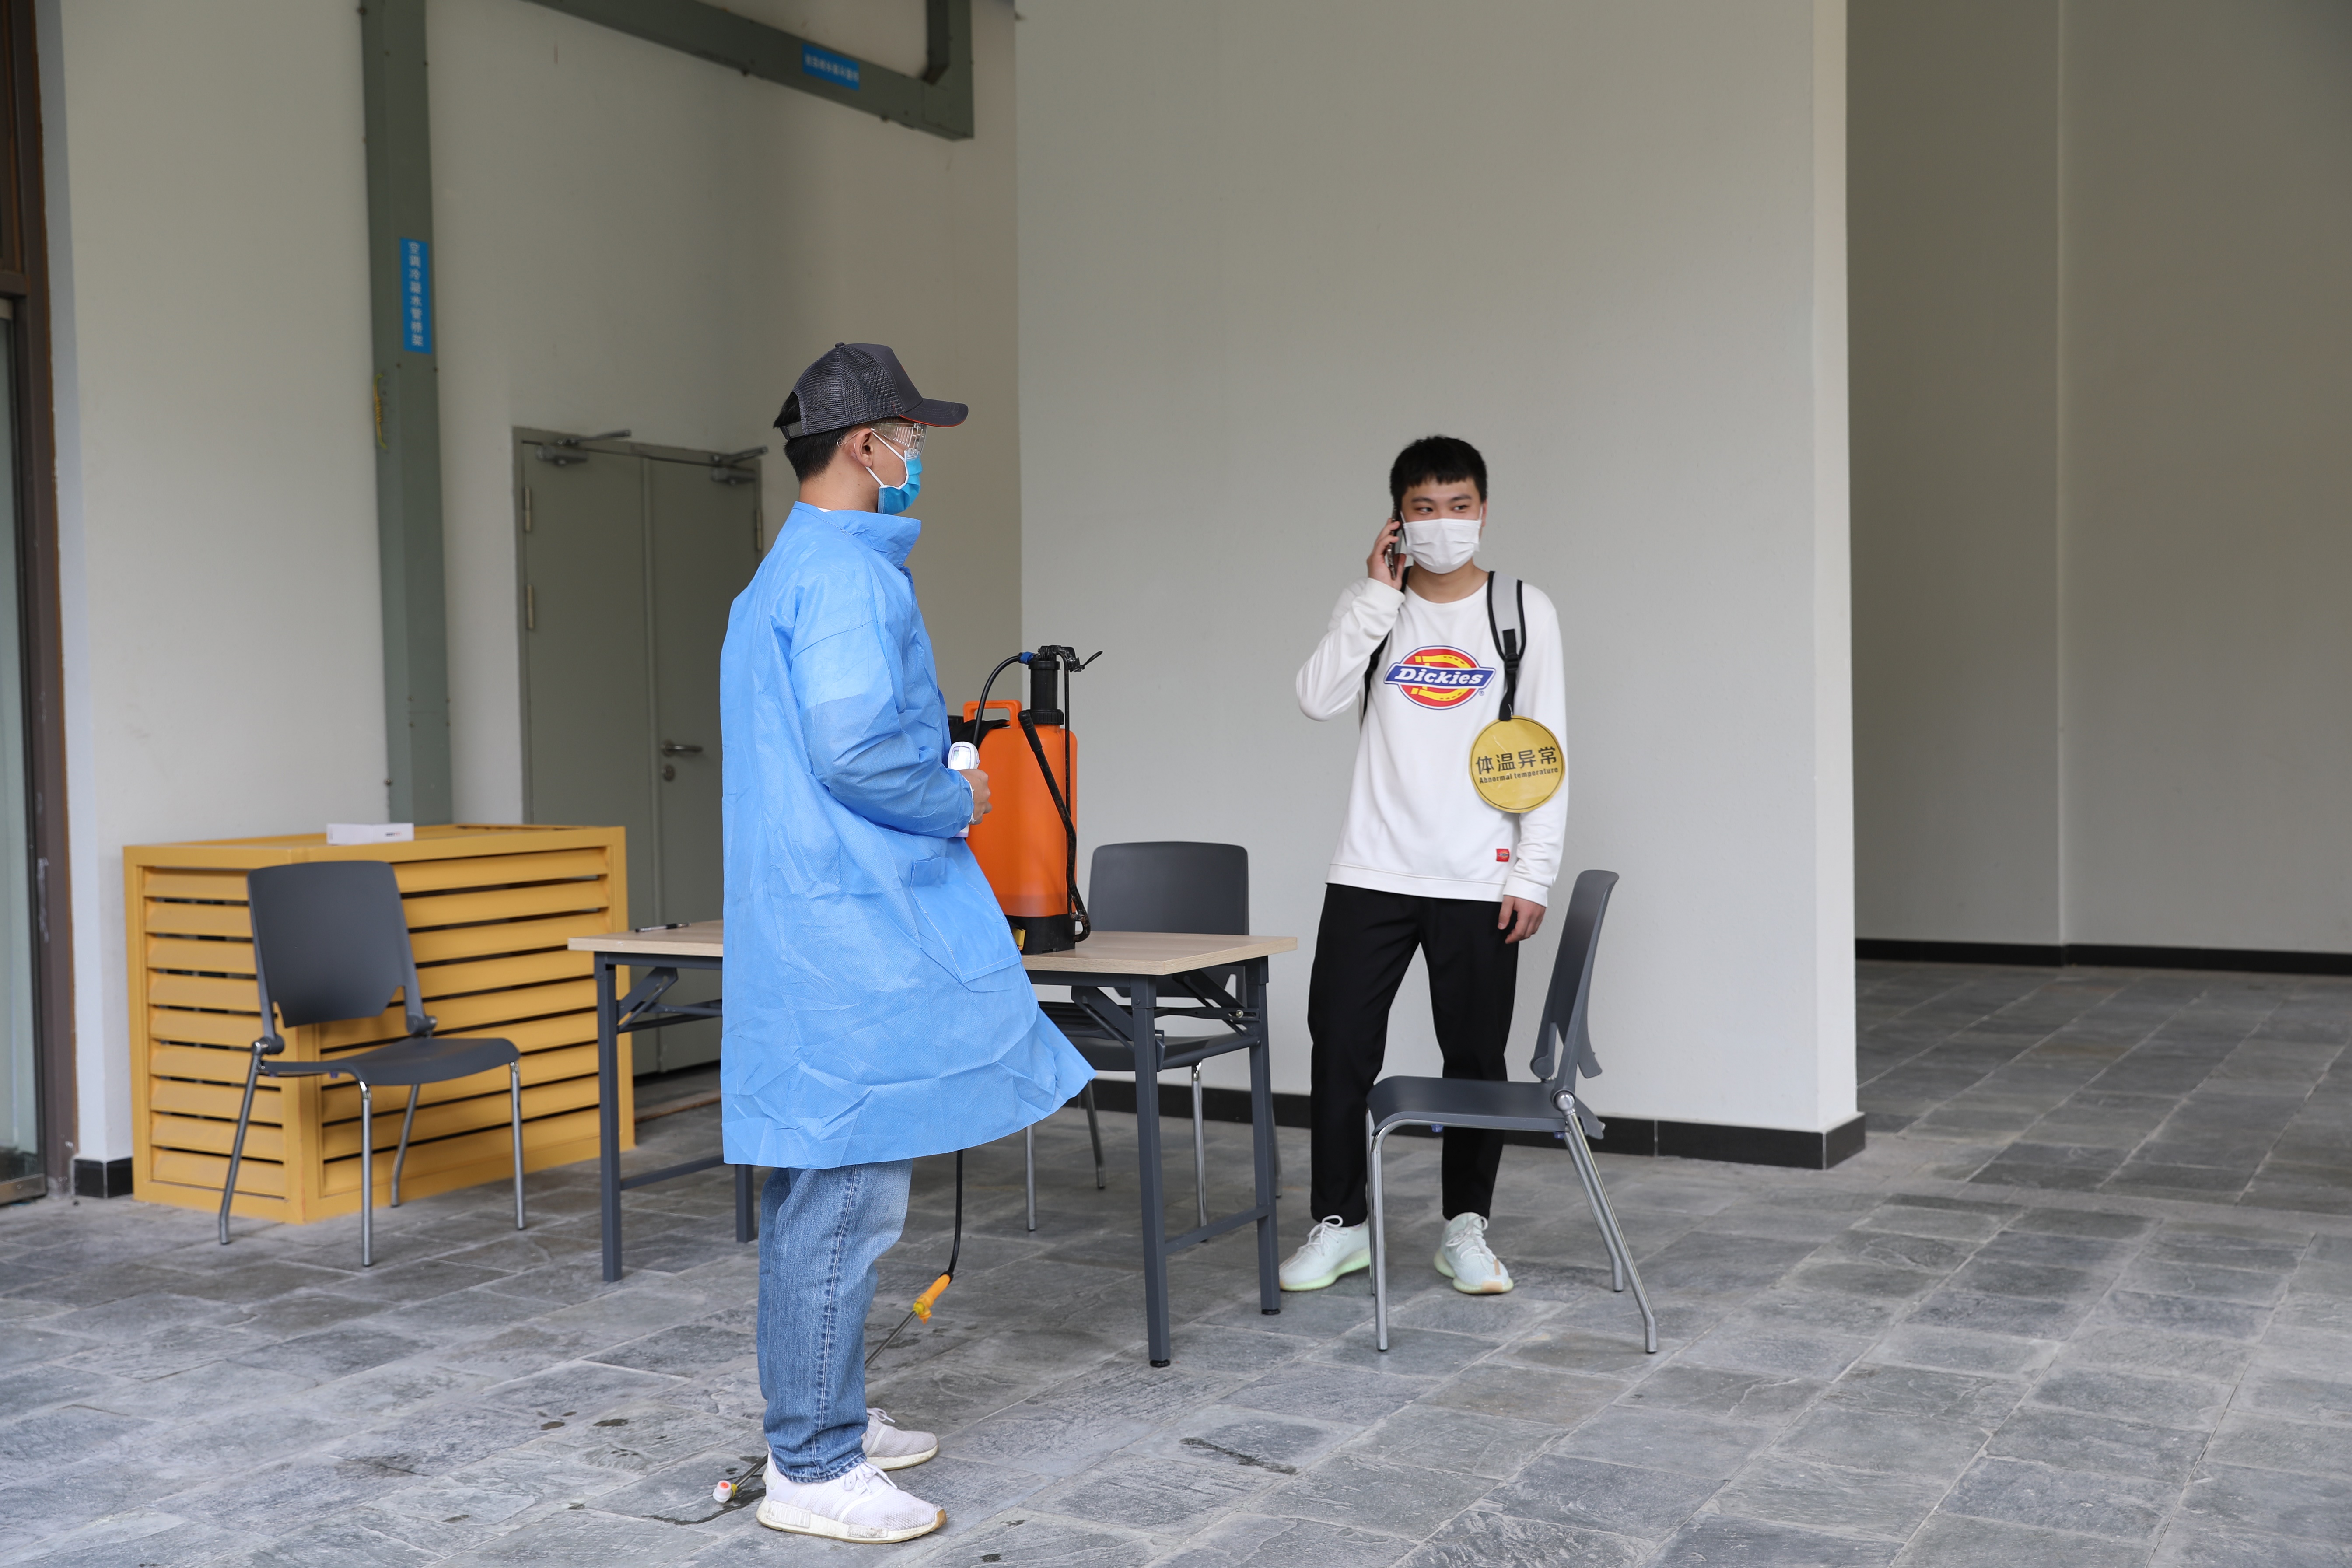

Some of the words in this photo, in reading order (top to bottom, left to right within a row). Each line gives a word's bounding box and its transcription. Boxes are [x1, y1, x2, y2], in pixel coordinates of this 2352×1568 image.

[1394, 668, 1484, 684] Dickies
[1476, 746, 1557, 774] 体温异常
[1479, 774, 1512, 784] Abnormal
[1514, 767, 1558, 778] temperature
